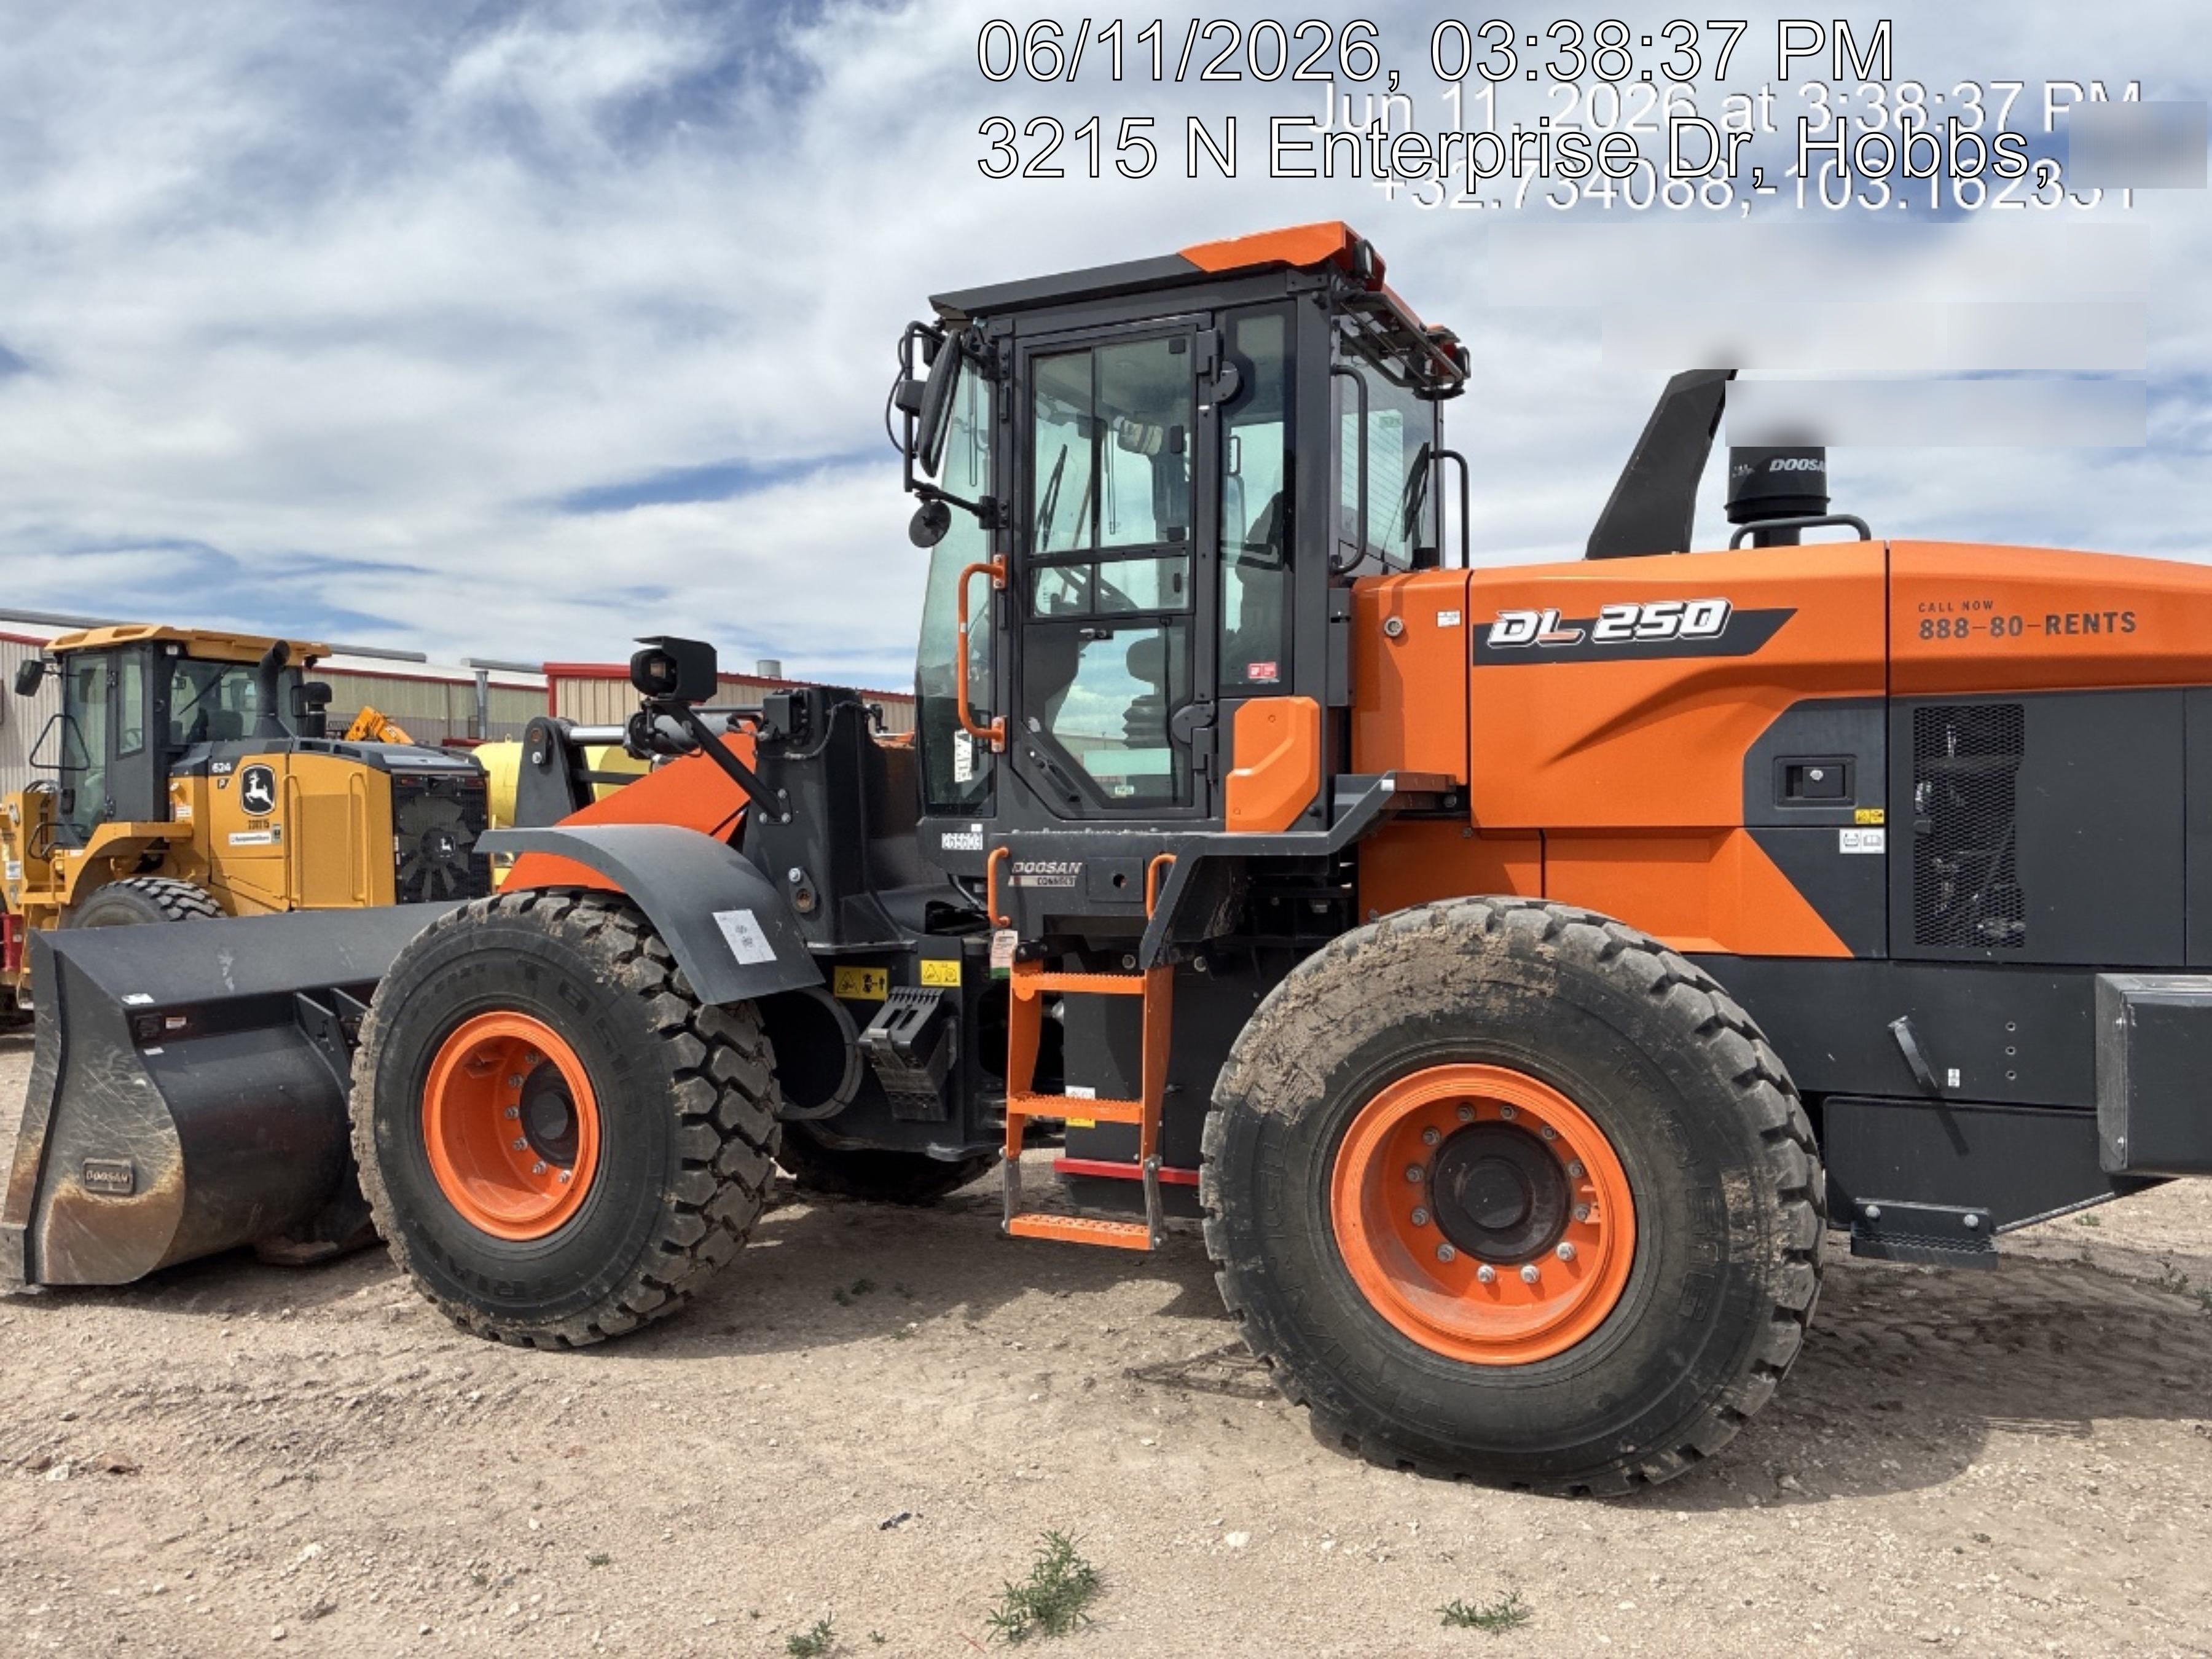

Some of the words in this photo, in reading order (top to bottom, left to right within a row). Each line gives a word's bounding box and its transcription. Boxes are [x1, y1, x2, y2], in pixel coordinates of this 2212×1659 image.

[1918, 602, 1954, 613] CALL
[1963, 600, 1994, 611] NOW
[1487, 609, 1585, 648] DL
[1591, 598, 1732, 643] 250
[1918, 611, 2137, 640] 888-80-RENTS
[1011, 862, 1083, 874] DOOSAN
